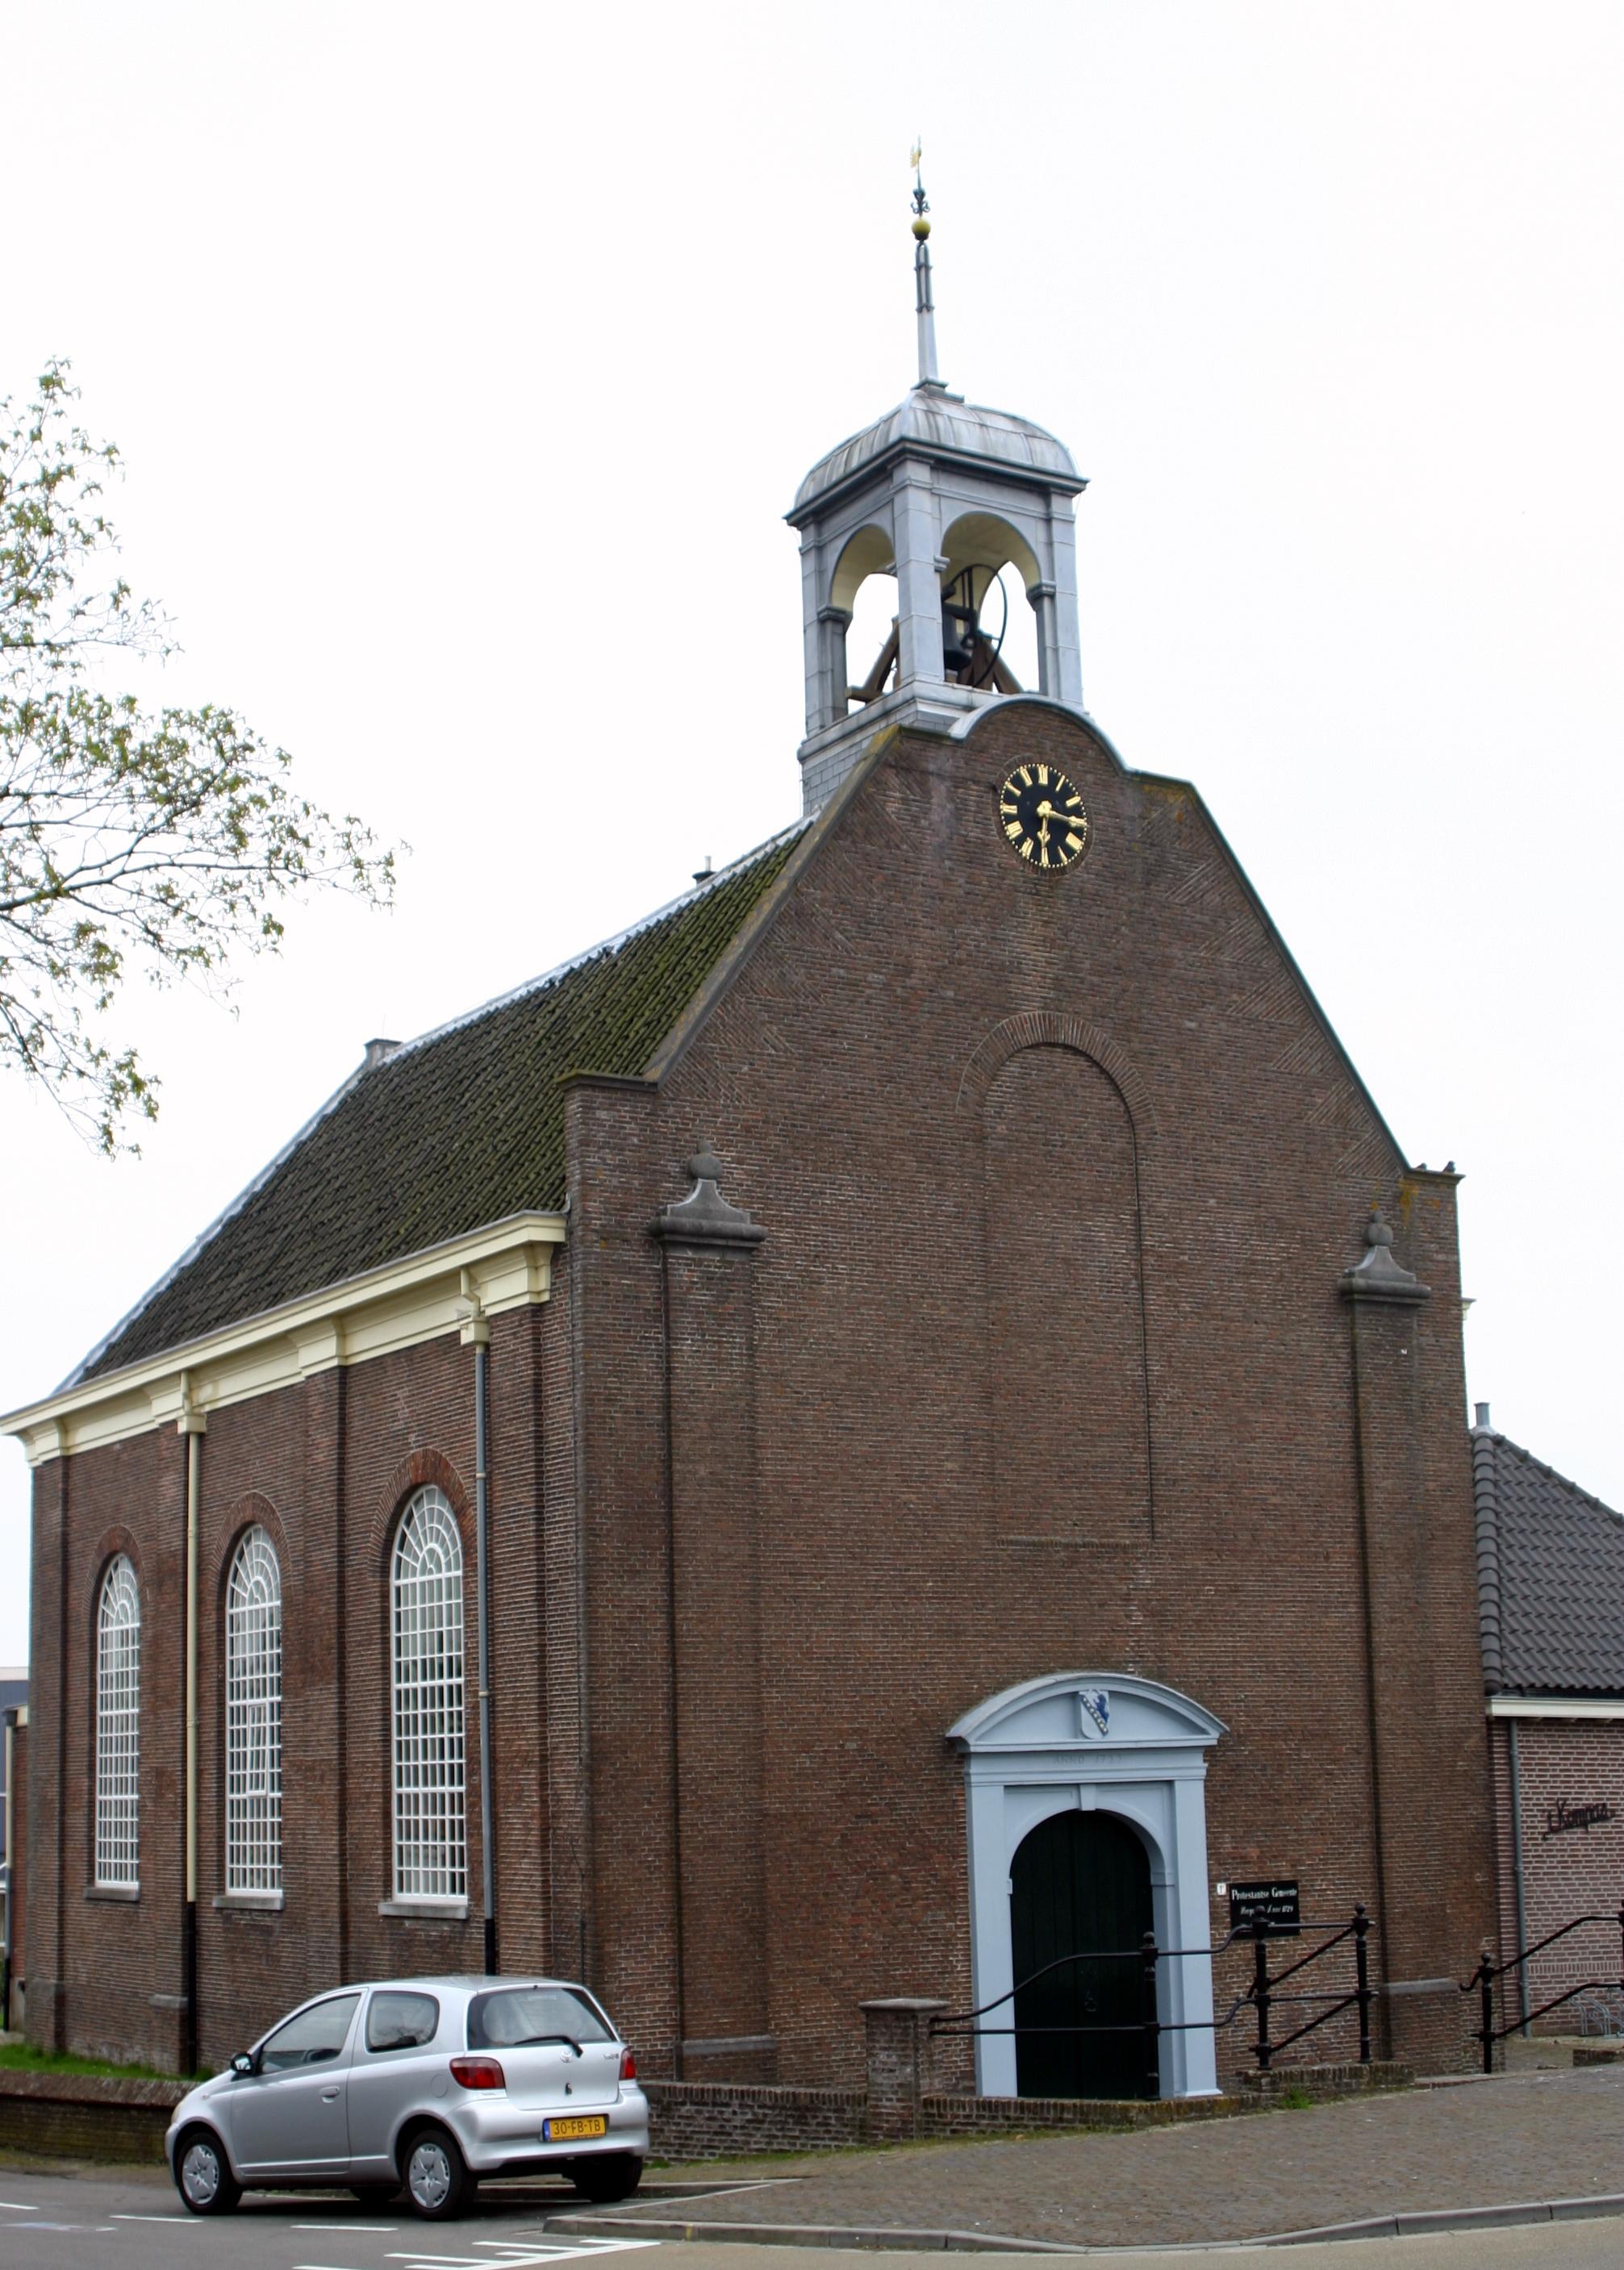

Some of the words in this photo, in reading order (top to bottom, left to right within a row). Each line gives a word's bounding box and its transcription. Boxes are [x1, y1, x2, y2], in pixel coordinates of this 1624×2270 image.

[1231, 1889, 1270, 1901] Protestantse
[1271, 1887, 1297, 1897] Gemeente
[553, 2119, 601, 2135] 30-FB-TB
